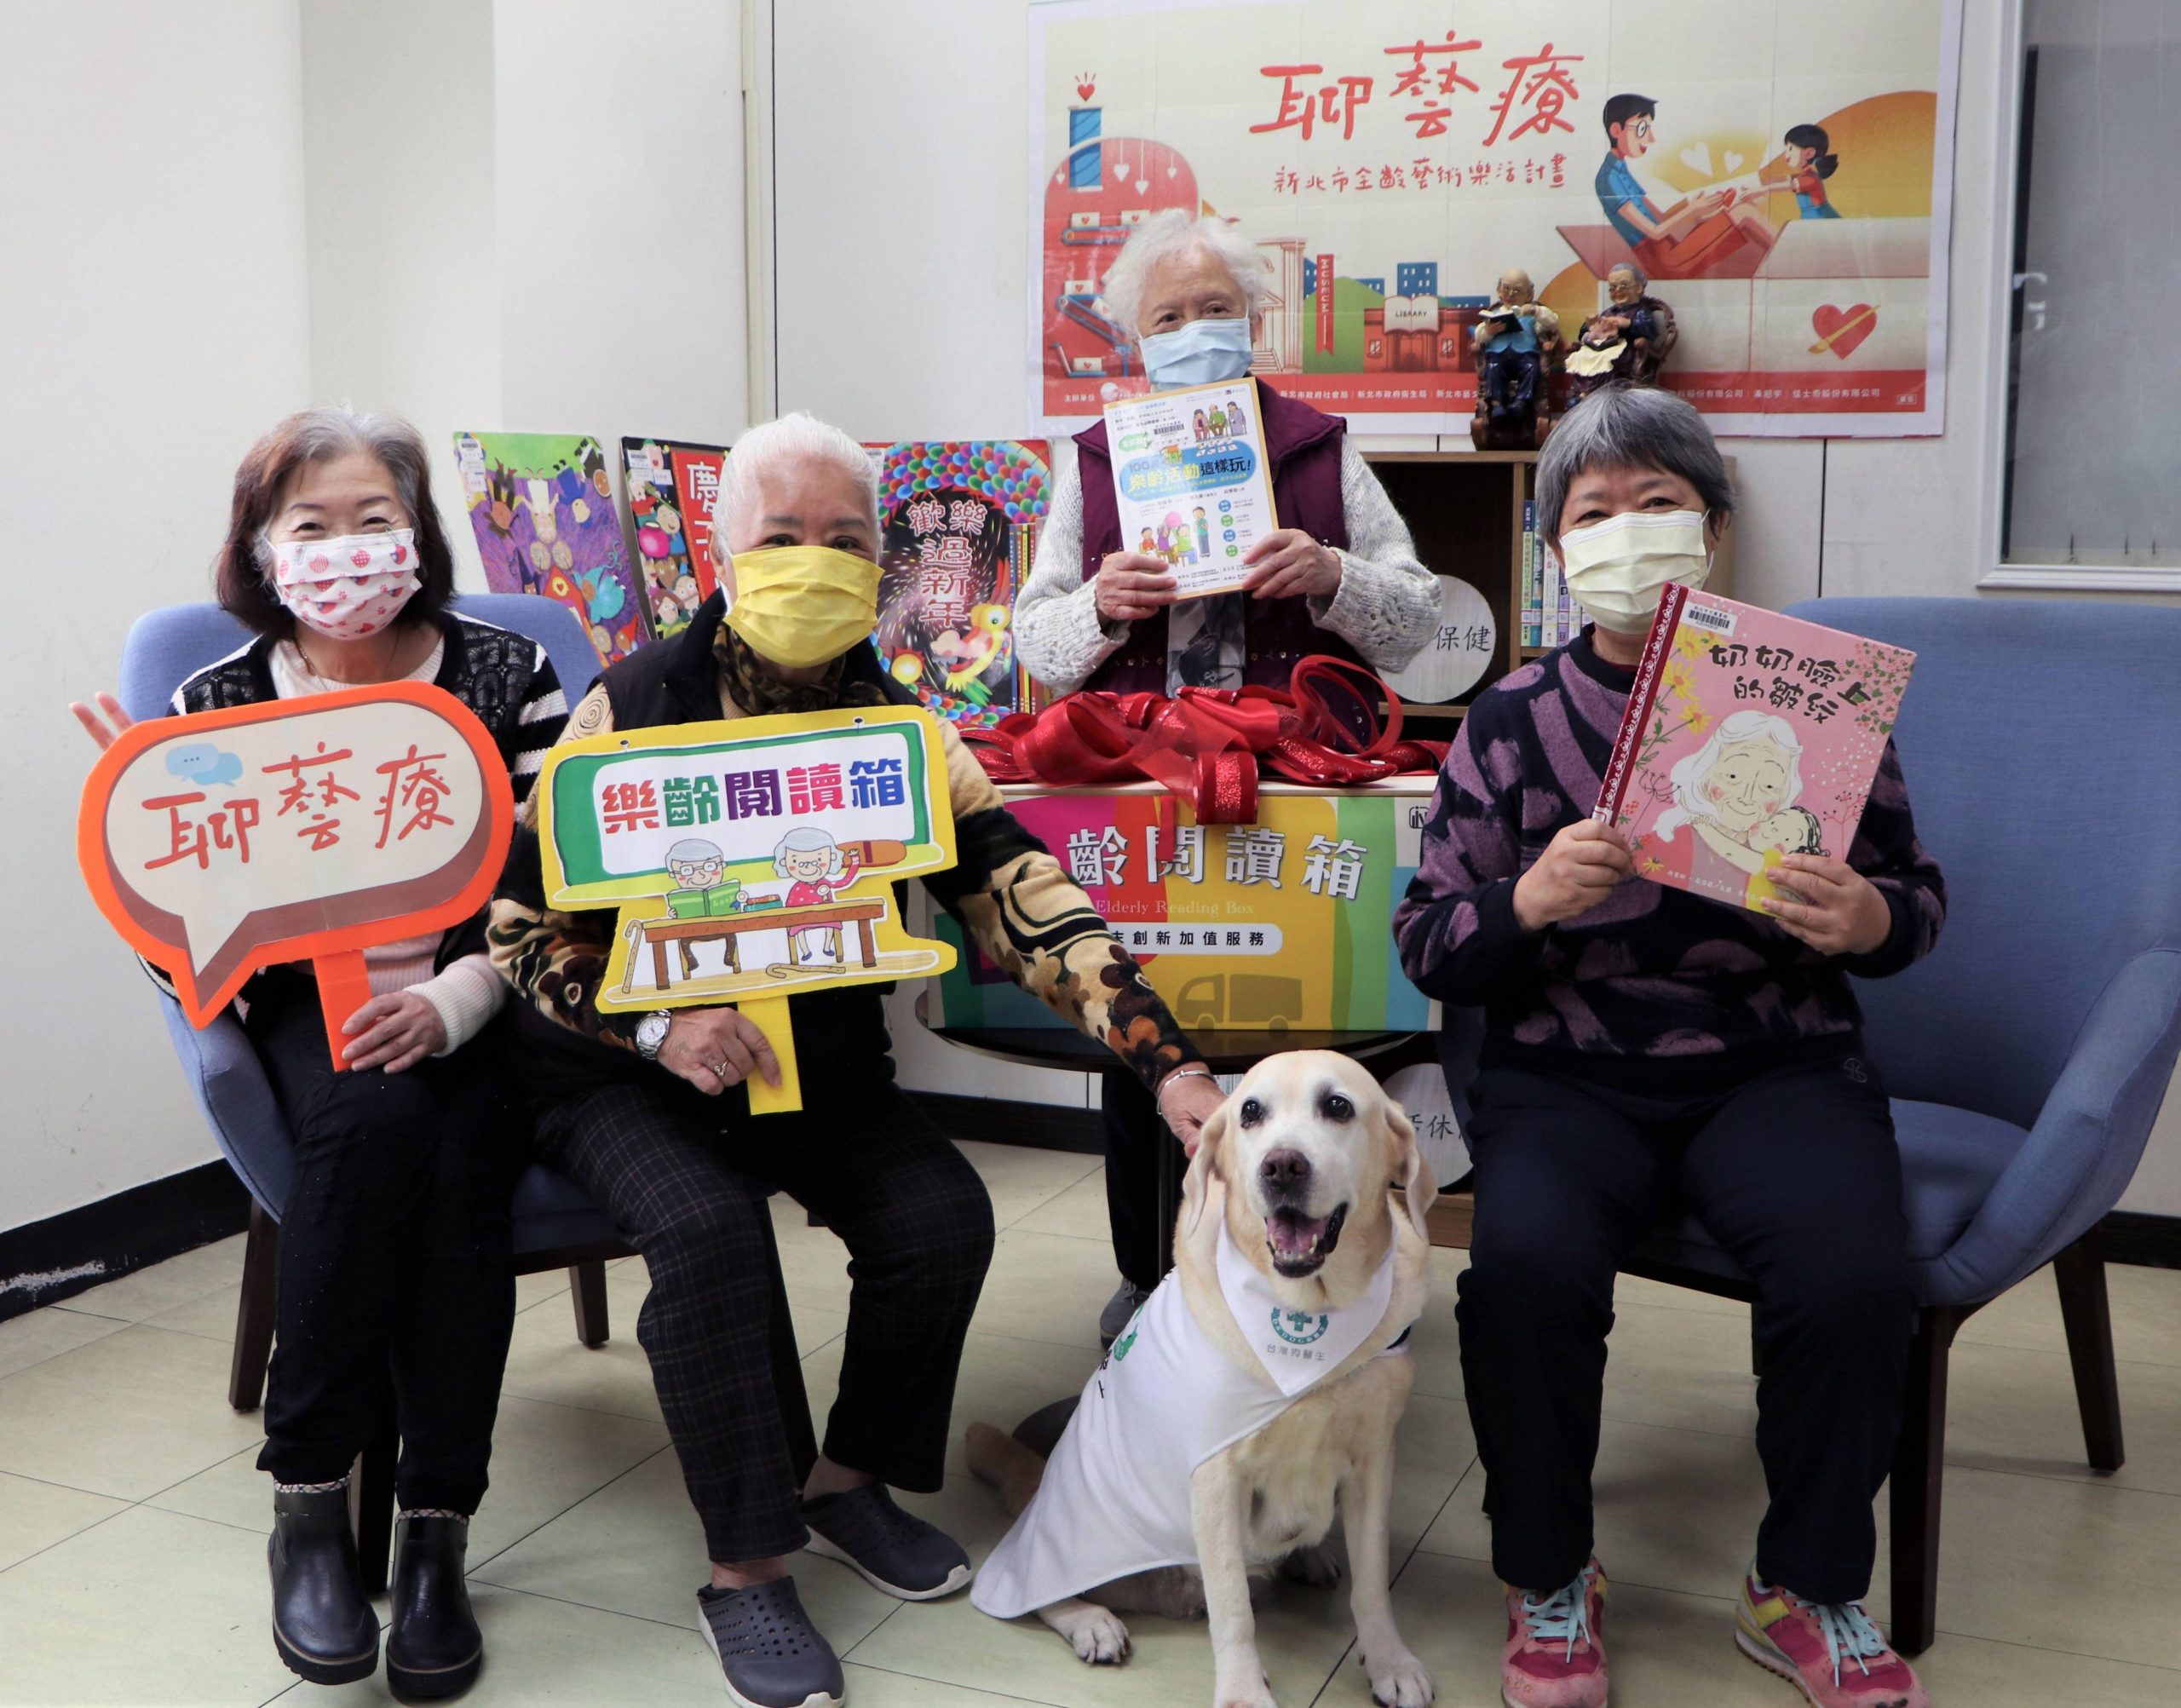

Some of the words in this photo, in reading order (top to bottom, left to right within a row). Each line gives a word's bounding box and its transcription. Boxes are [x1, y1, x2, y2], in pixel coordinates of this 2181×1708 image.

[1249, 29, 1585, 147] 聊藝療
[1274, 153, 1567, 194] 新北市全齡藝術樂活計畫
[1321, 258, 1330, 313] MUSEUM
[906, 499, 988, 537] 歡樂
[918, 536, 973, 628] 過新年
[141, 740, 456, 871] 聊藝療
[601, 756, 906, 835] 樂齡閱讀箱
[1096, 900, 1148, 914] Elderly
[1155, 900, 1219, 917] Reading
[1226, 900, 1255, 914] Box
